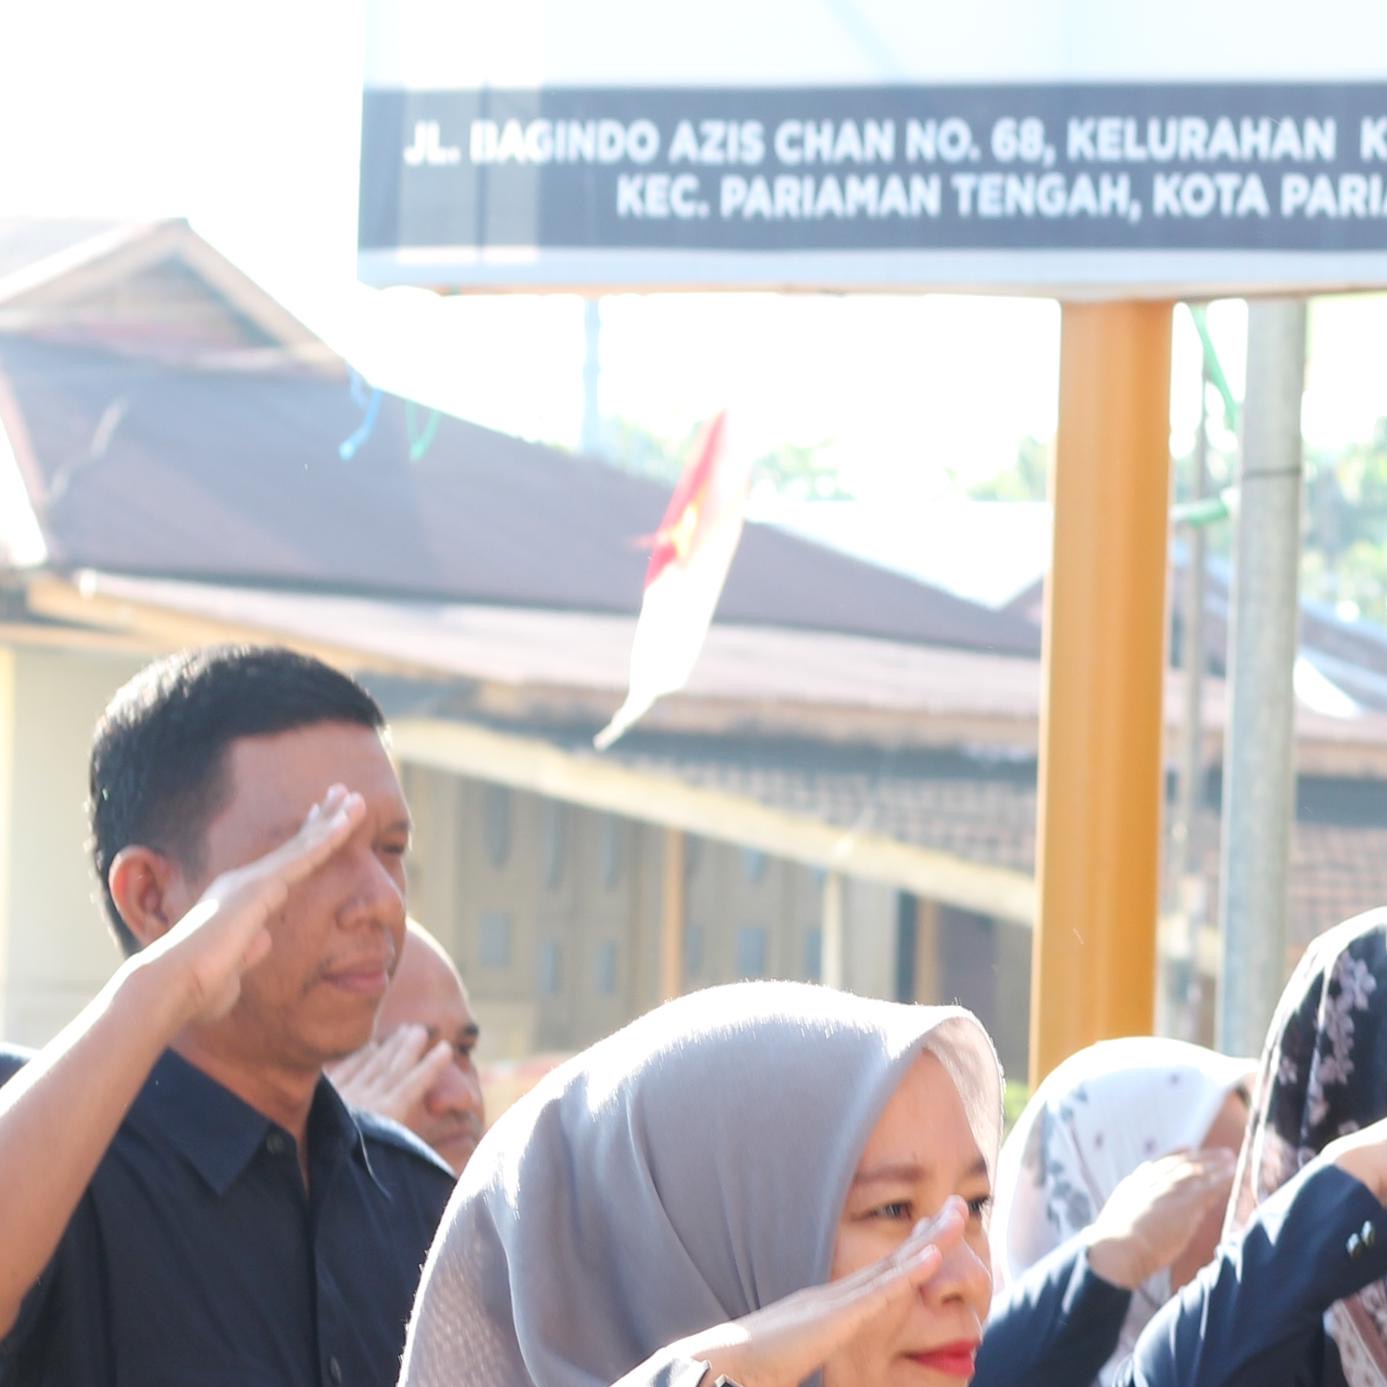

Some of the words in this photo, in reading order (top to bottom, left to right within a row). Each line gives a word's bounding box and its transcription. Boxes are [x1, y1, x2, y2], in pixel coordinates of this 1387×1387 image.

[404, 120, 459, 164] JL.
[470, 119, 660, 164] BAGINDO
[668, 119, 765, 163] AZIS
[773, 119, 895, 163] CHAN
[906, 118, 979, 161] NO.
[991, 118, 1055, 165] 68,
[1067, 116, 1336, 160] KELURAHAN
[617, 174, 709, 218] KEC.
[720, 175, 941, 218] PARIAMAN
[952, 174, 1140, 221] TENGAH,
[1153, 173, 1269, 216] KOTA
